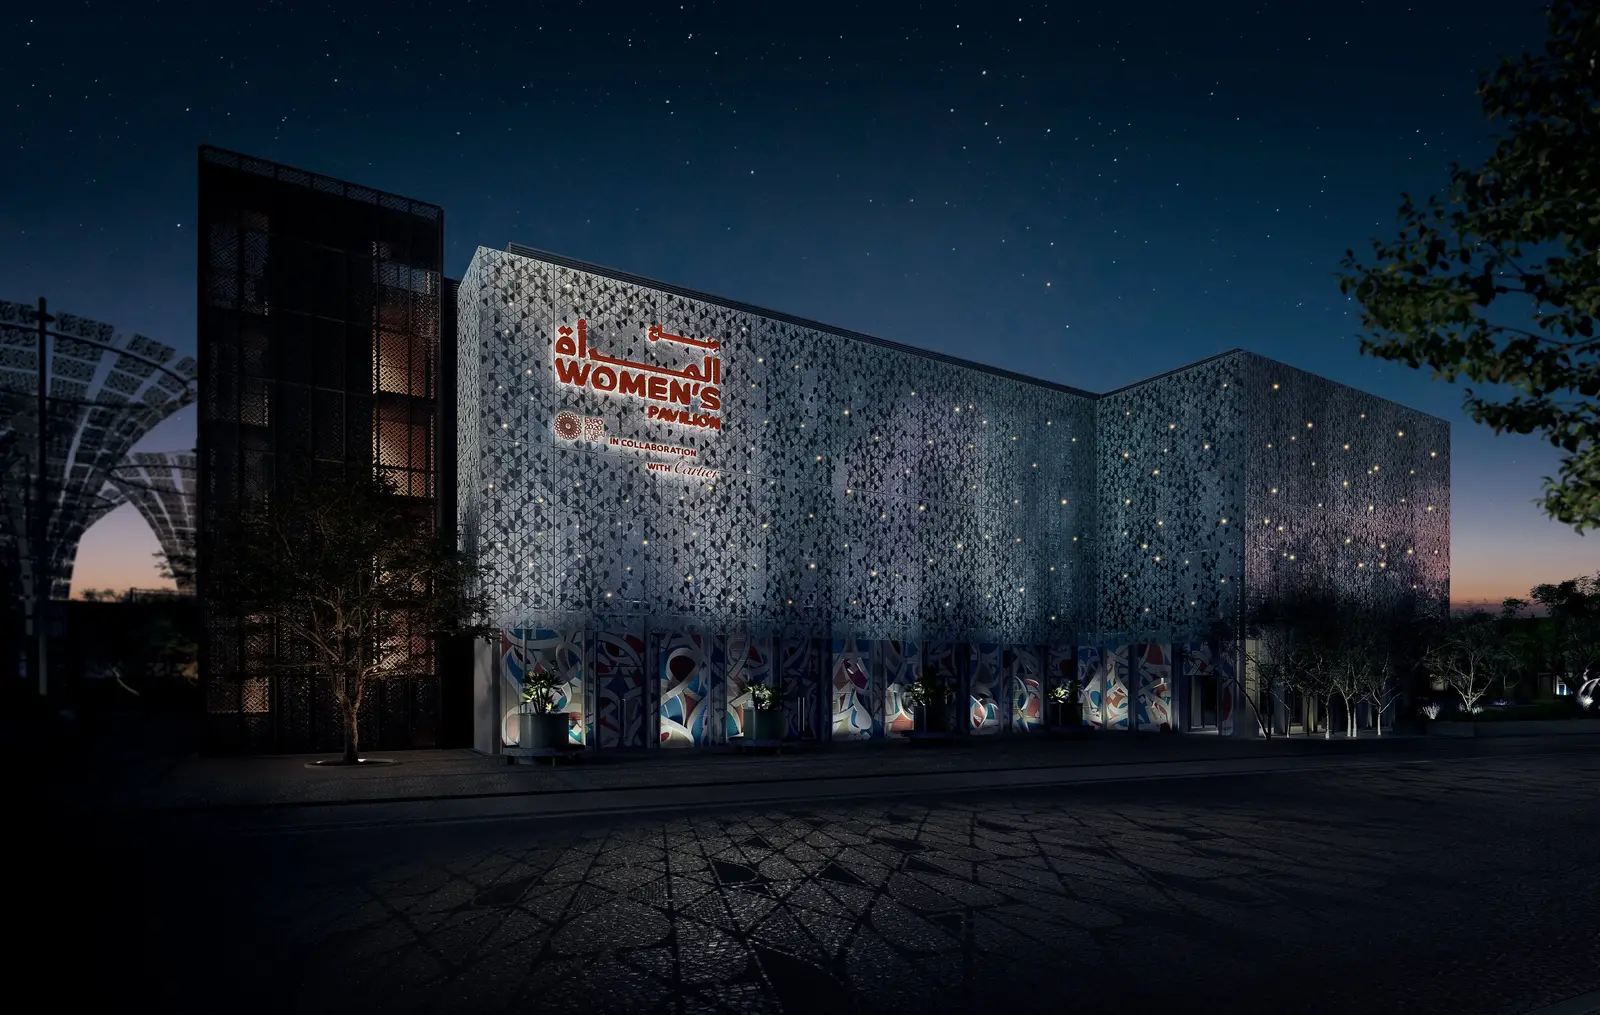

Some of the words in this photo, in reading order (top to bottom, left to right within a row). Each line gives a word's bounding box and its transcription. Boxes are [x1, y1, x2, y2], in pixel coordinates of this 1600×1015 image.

[555, 319, 721, 385] المرأة
[555, 358, 721, 411] WOMEN'S
[584, 417, 604, 426] EXPO
[647, 405, 721, 430] PAVILION
[584, 424, 603, 432] 2020
[609, 437, 620, 446] IN
[621, 439, 698, 457] COLLABORATION
[647, 462, 671, 473] WITH
[673, 459, 720, 479] Cartier
